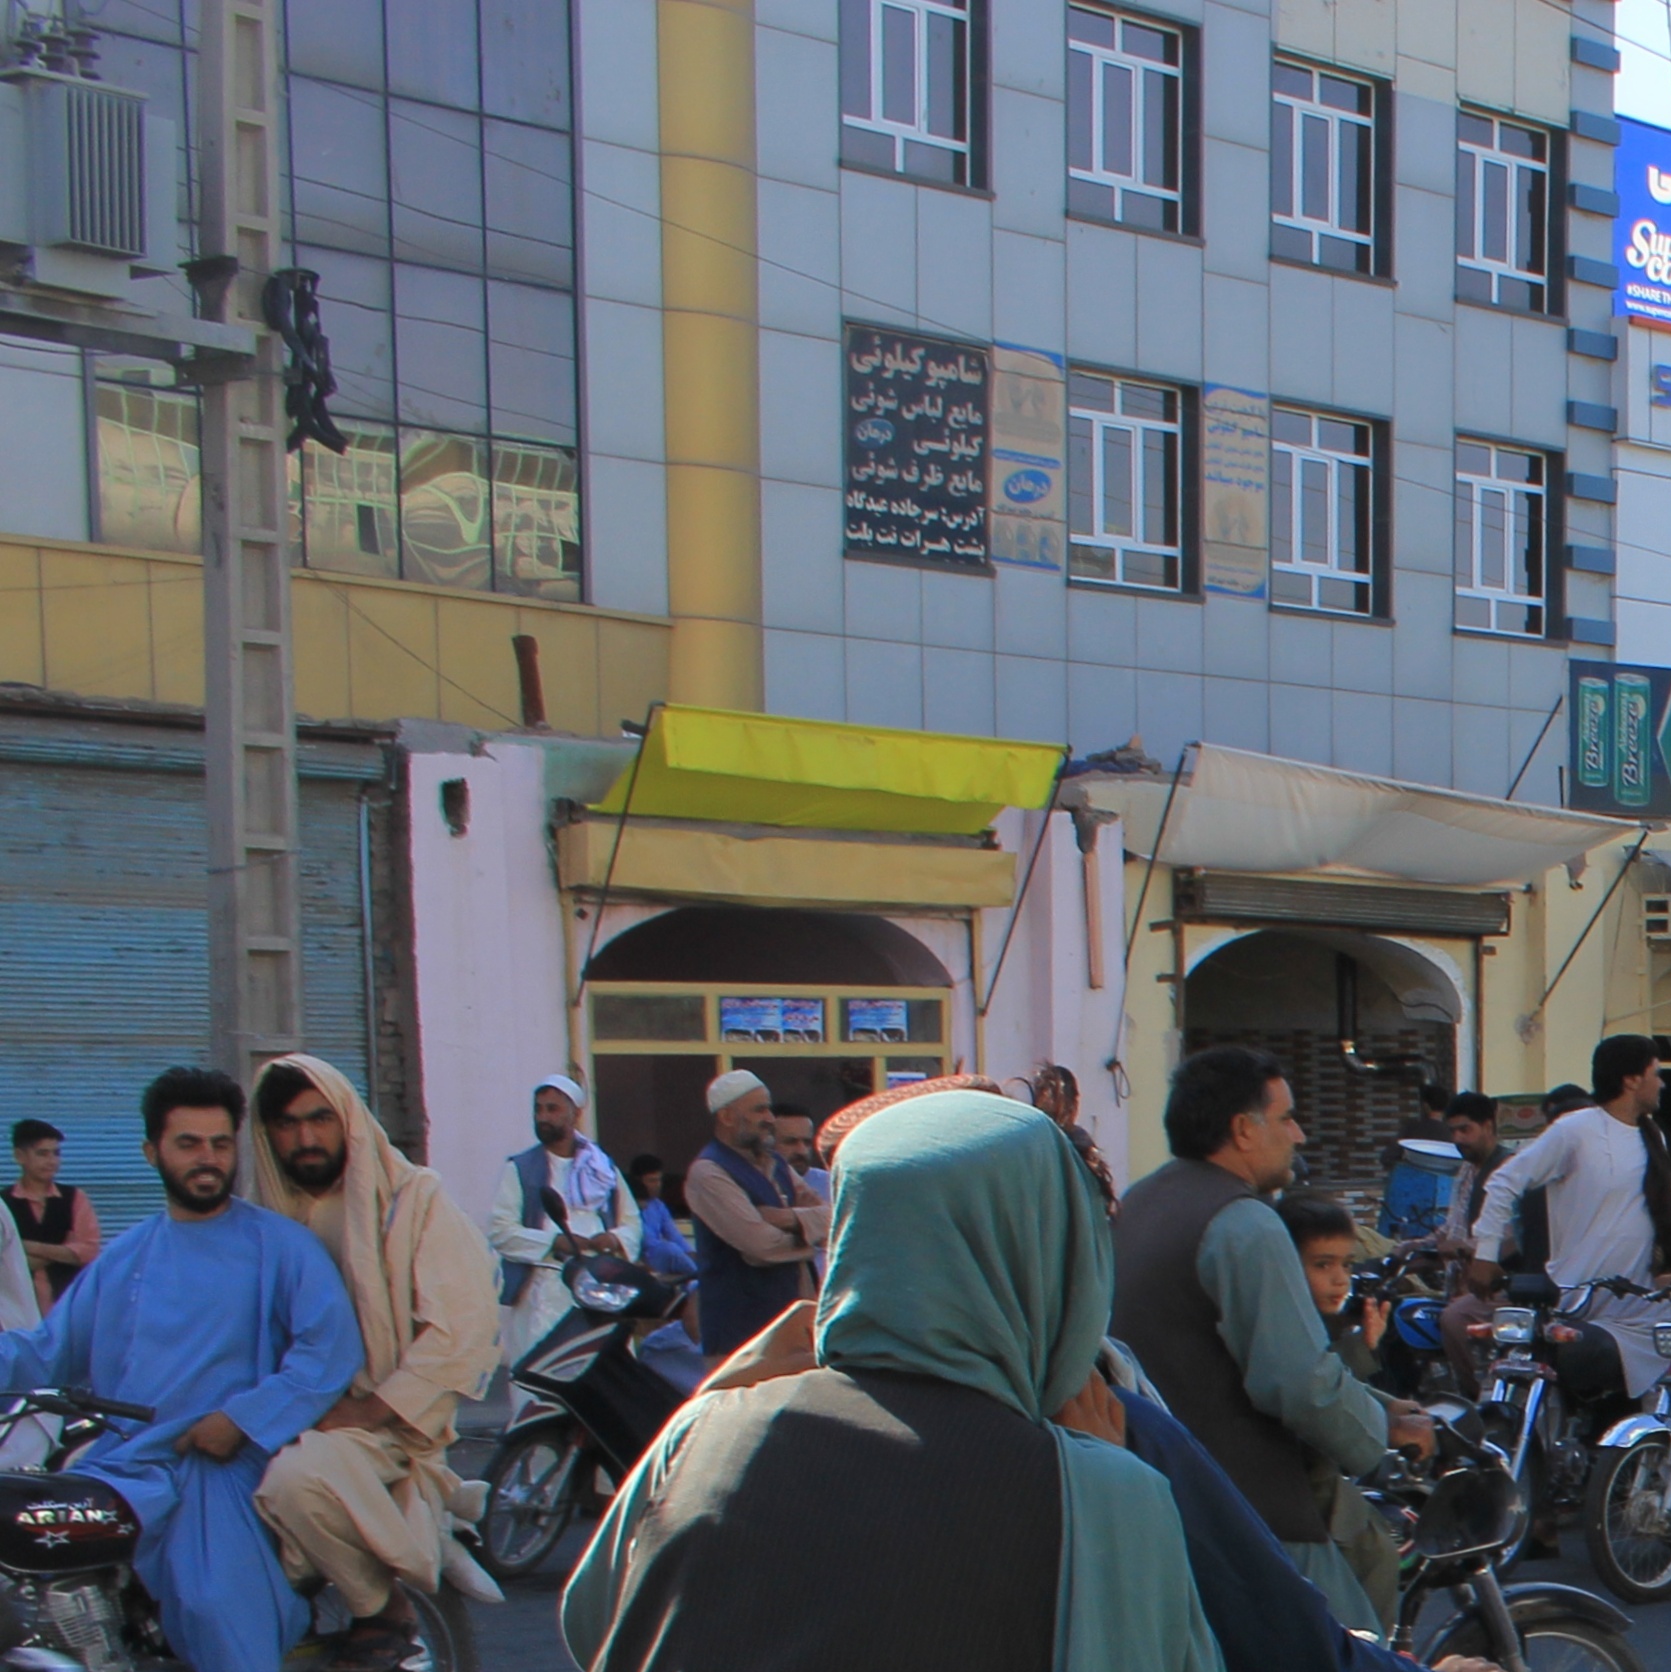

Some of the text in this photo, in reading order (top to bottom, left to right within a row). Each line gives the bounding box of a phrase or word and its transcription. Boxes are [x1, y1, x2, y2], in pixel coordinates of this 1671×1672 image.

[926, 355, 982, 389] شامپو
[902, 394, 943, 423] لباس
[948, 402, 983, 429] مایع
[948, 470, 983, 497] مایع
[1622, 700, 1640, 787] Breeze
[17, 1509, 103, 1525] ARIAN
